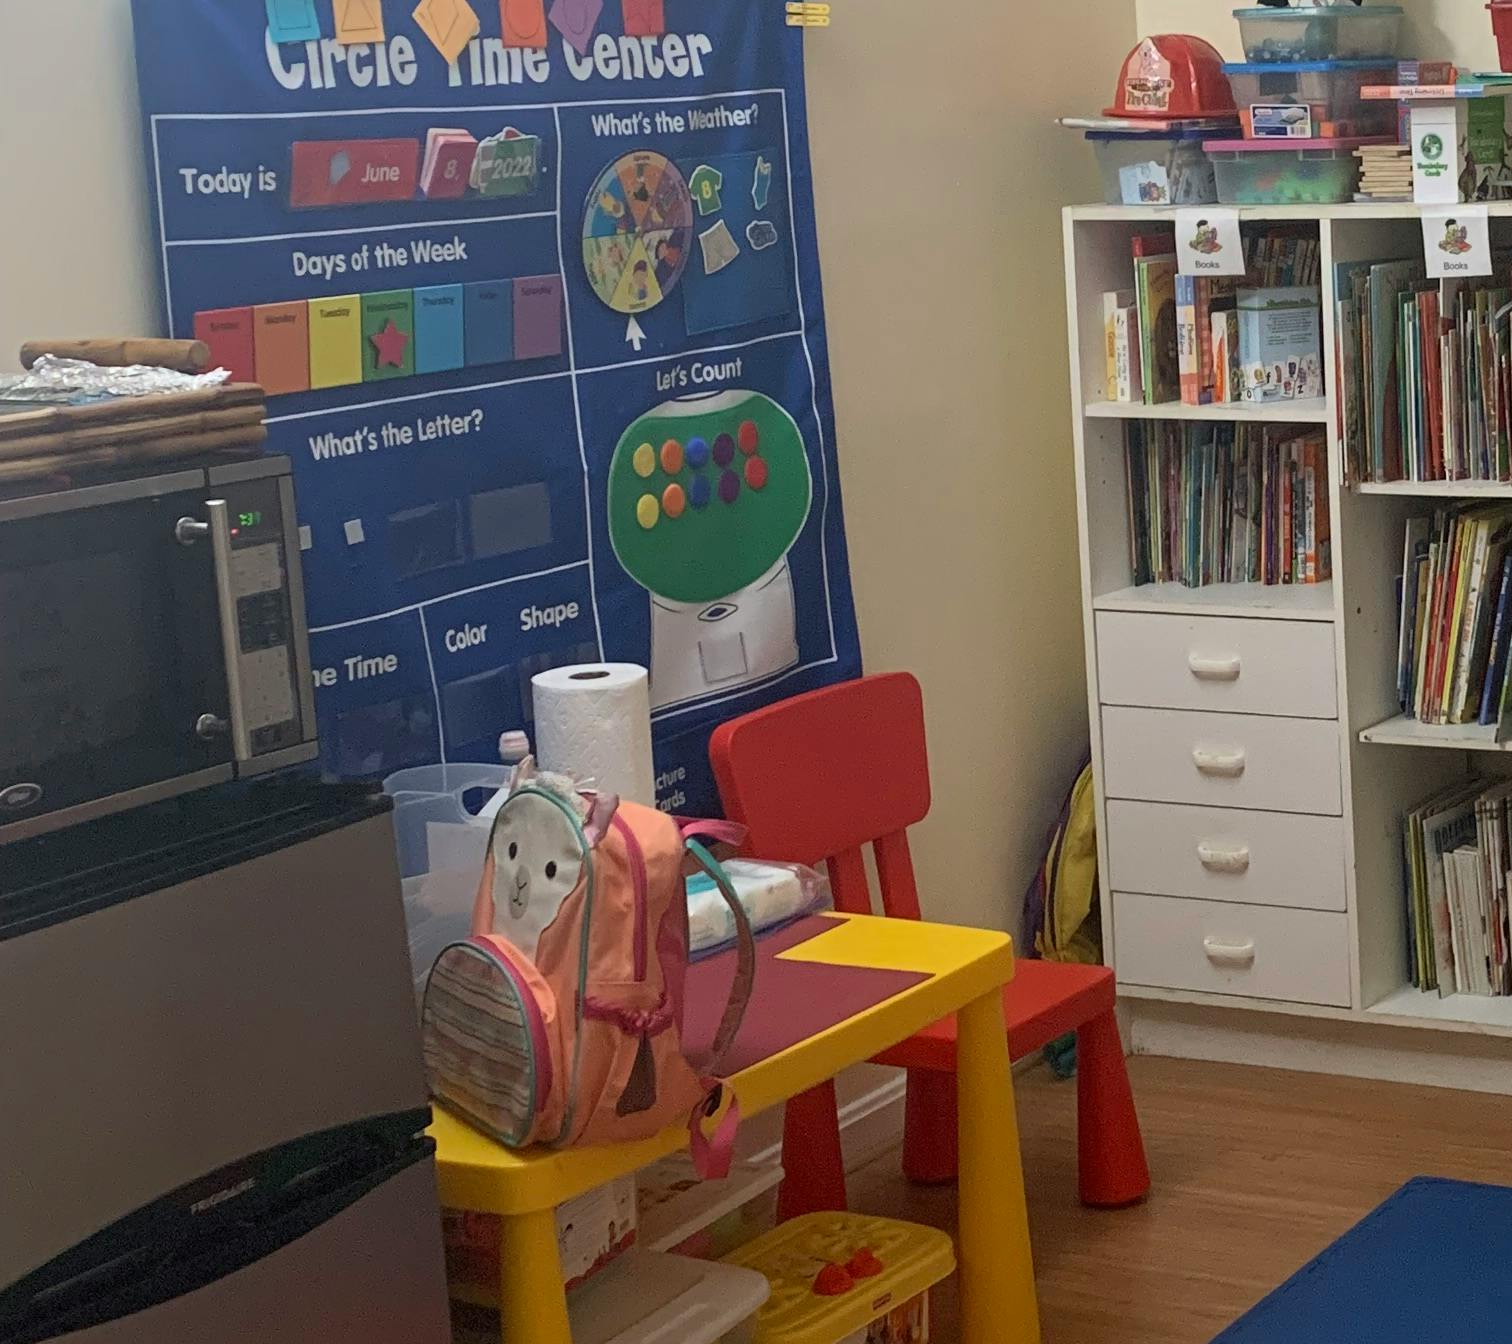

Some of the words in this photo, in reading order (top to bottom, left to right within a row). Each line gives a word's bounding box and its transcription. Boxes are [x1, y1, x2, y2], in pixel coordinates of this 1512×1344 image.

[265, 25, 418, 90] Circle
[592, 111, 651, 136] What's
[655, 114, 685, 134] the
[688, 103, 758, 131] Weather?
[179, 167, 251, 199] Today
[258, 165, 277, 192] is
[360, 162, 400, 183] June
[492, 156, 533, 179] 2022
[292, 251, 346, 280] Days
[351, 244, 369, 270] of
[374, 242, 408, 268] the
[410, 236, 467, 264] Week
[1194, 260, 1221, 270] Books
[1443, 261, 1469, 271] Books
[656, 364, 687, 391] Let's
[691, 357, 742, 383] Count
[308, 426, 378, 461] What's
[381, 422, 413, 448] the
[417, 409, 484, 442] Letter?
[520, 601, 579, 631] Shape
[445, 623, 487, 653] Color
[344, 653, 398, 681] Time
